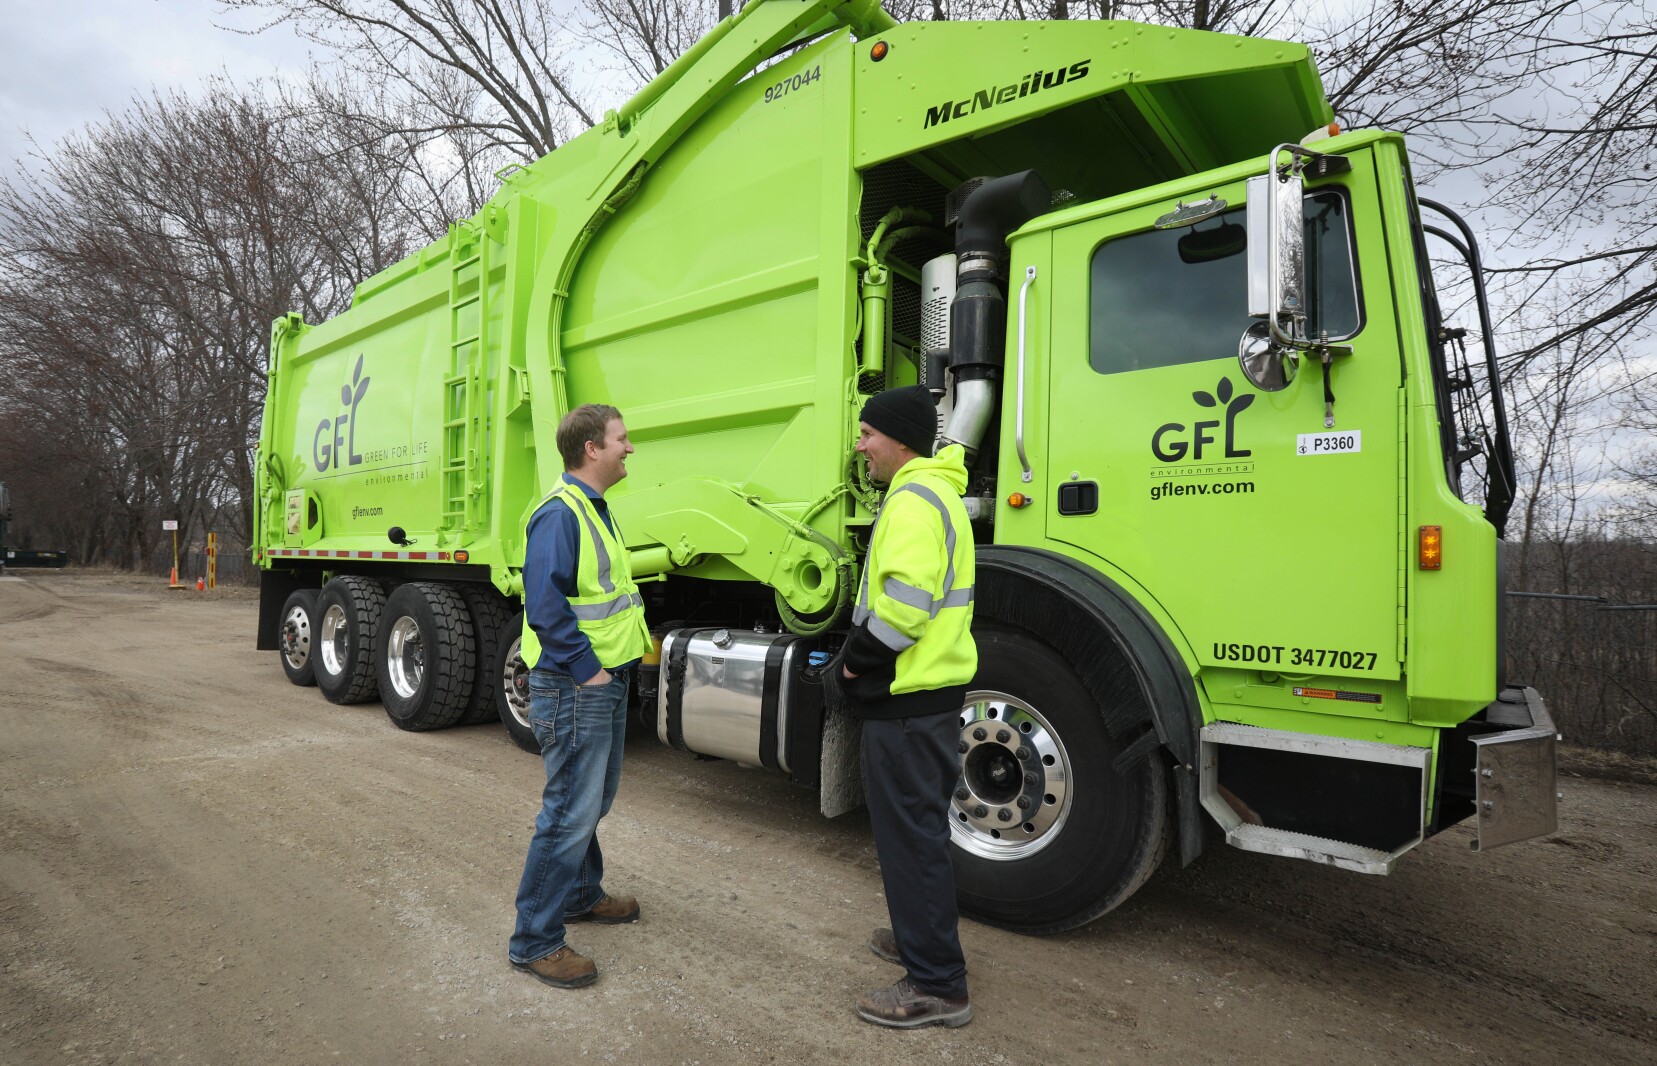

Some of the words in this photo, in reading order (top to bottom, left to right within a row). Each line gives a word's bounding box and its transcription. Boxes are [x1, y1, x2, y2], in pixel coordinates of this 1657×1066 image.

[765, 65, 821, 103] 927044
[923, 58, 1092, 130] McNeilus
[313, 376, 371, 473] GFL
[1151, 393, 1256, 463] GFL
[364, 449, 389, 463] GREEN
[391, 445, 408, 459] FOR
[411, 441, 428, 456] LIFE
[1314, 436, 1354, 451] P3360
[365, 467, 429, 486] environmental
[1150, 463, 1255, 477] environmental
[1150, 481, 1255, 501] gflenv.com
[352, 505, 383, 520] gflenv.com
[1213, 642, 1285, 664] USDOT
[1290, 648, 1378, 670] 3477027
